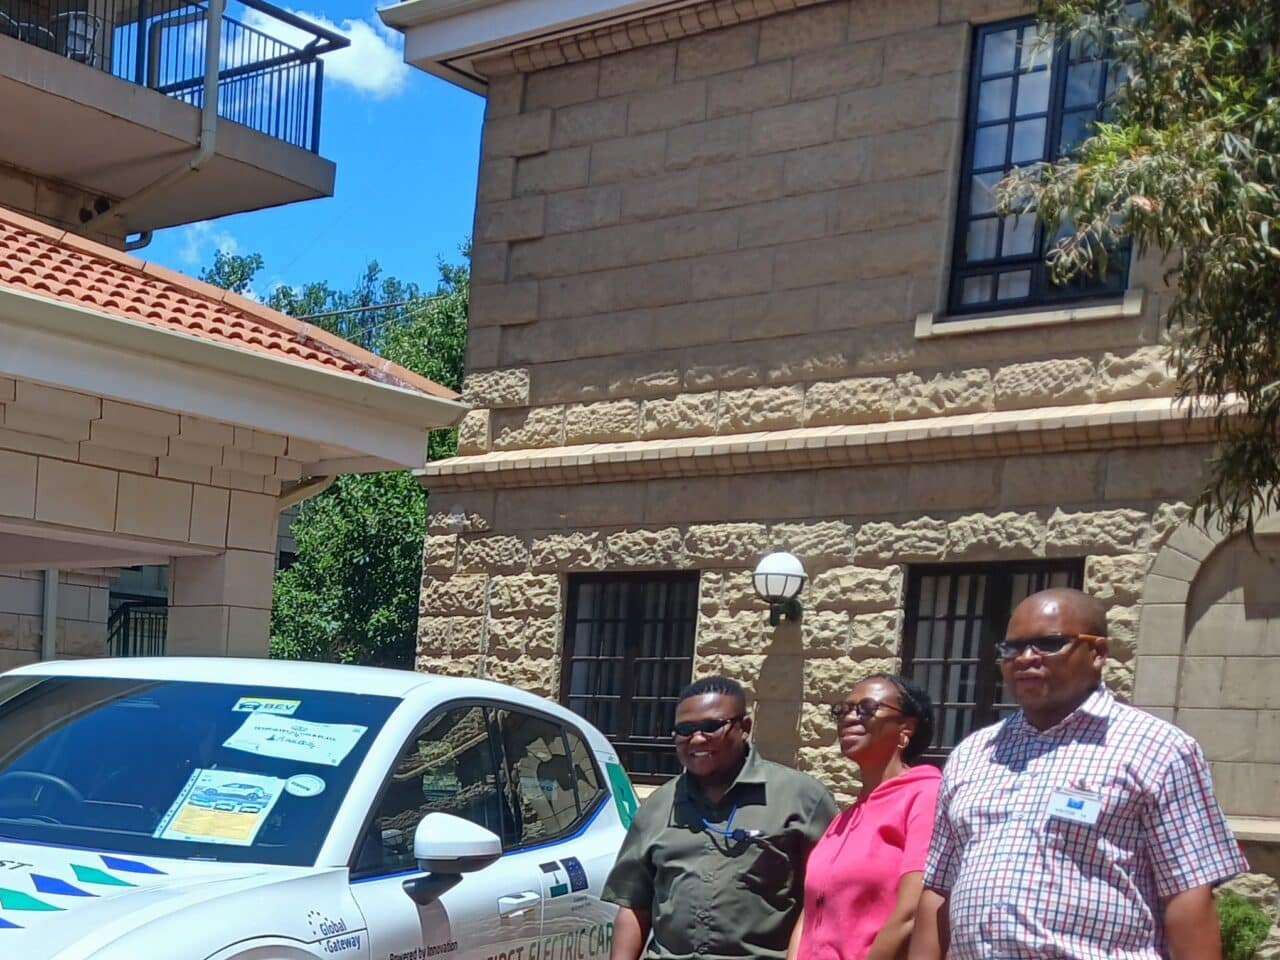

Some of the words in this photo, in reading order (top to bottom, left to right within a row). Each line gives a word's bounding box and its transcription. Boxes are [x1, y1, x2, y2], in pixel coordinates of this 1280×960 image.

[263, 702, 296, 711] BEV
[319, 917, 347, 936] Global
[326, 936, 361, 953] Gateway
[588, 921, 615, 956] CAR
[418, 946, 426, 960] by
[427, 939, 459, 957] Innovation
